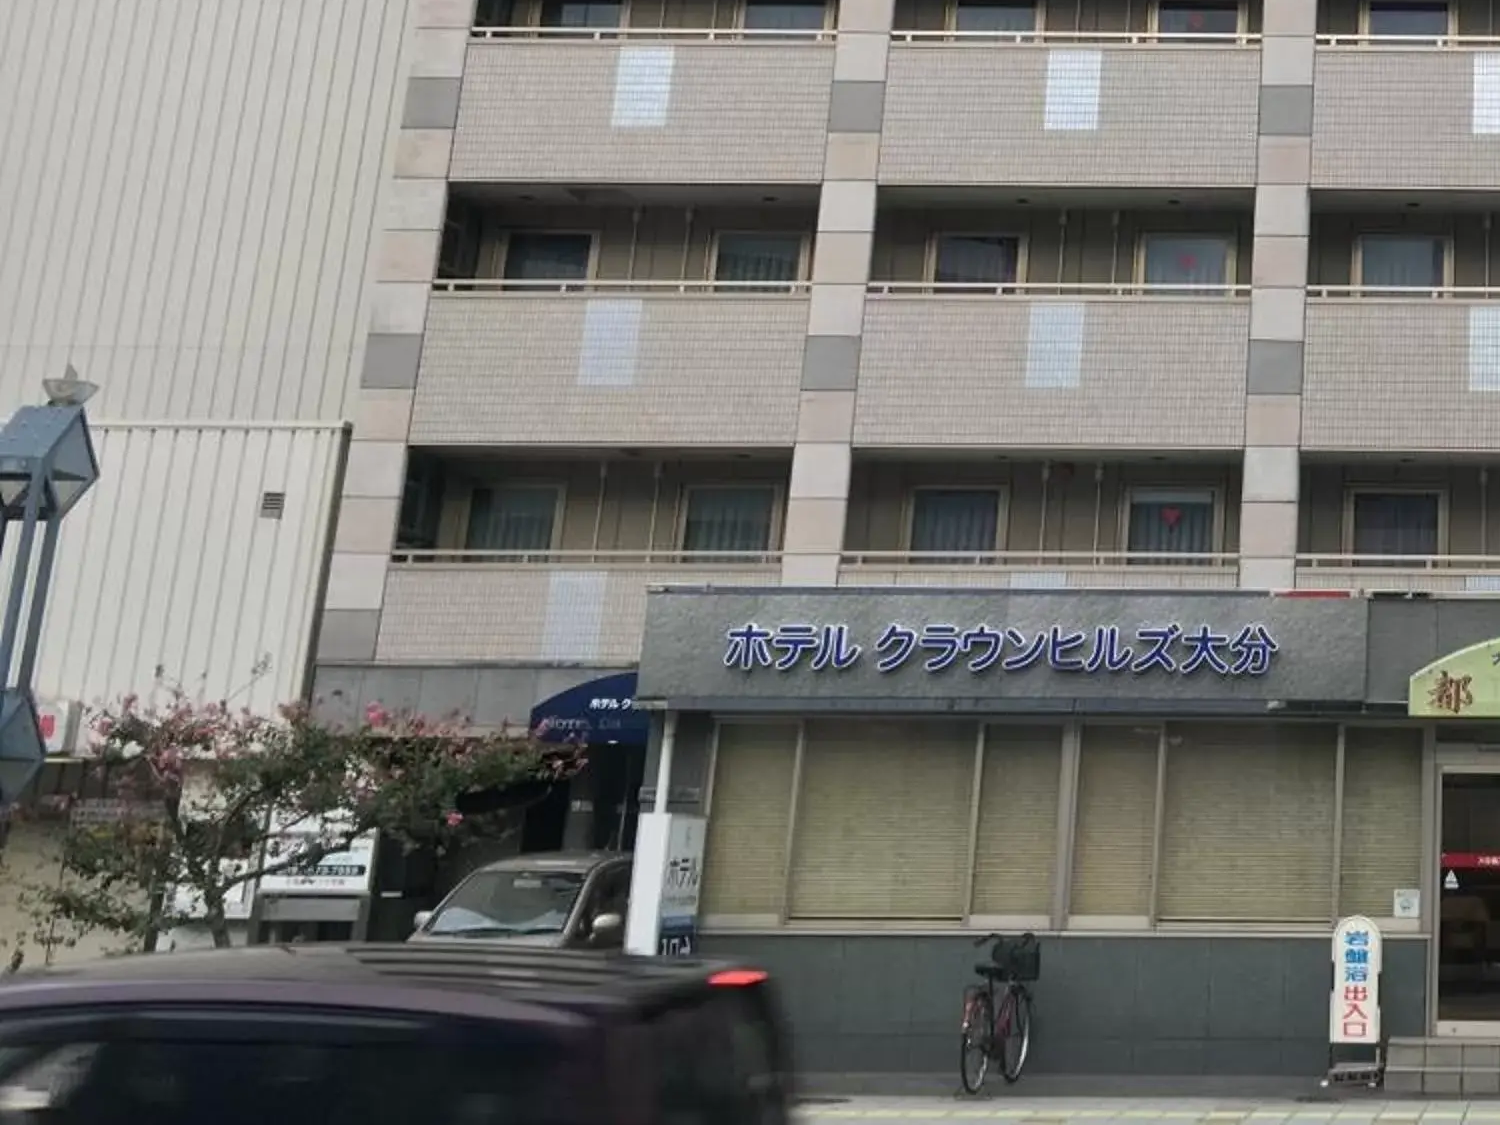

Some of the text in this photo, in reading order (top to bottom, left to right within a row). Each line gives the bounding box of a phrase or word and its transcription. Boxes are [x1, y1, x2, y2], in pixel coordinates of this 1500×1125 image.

[724, 625, 1279, 675] ホテル クラウンヒルズ大分
[1343, 931, 1369, 1038] 岩盤浴出入口
